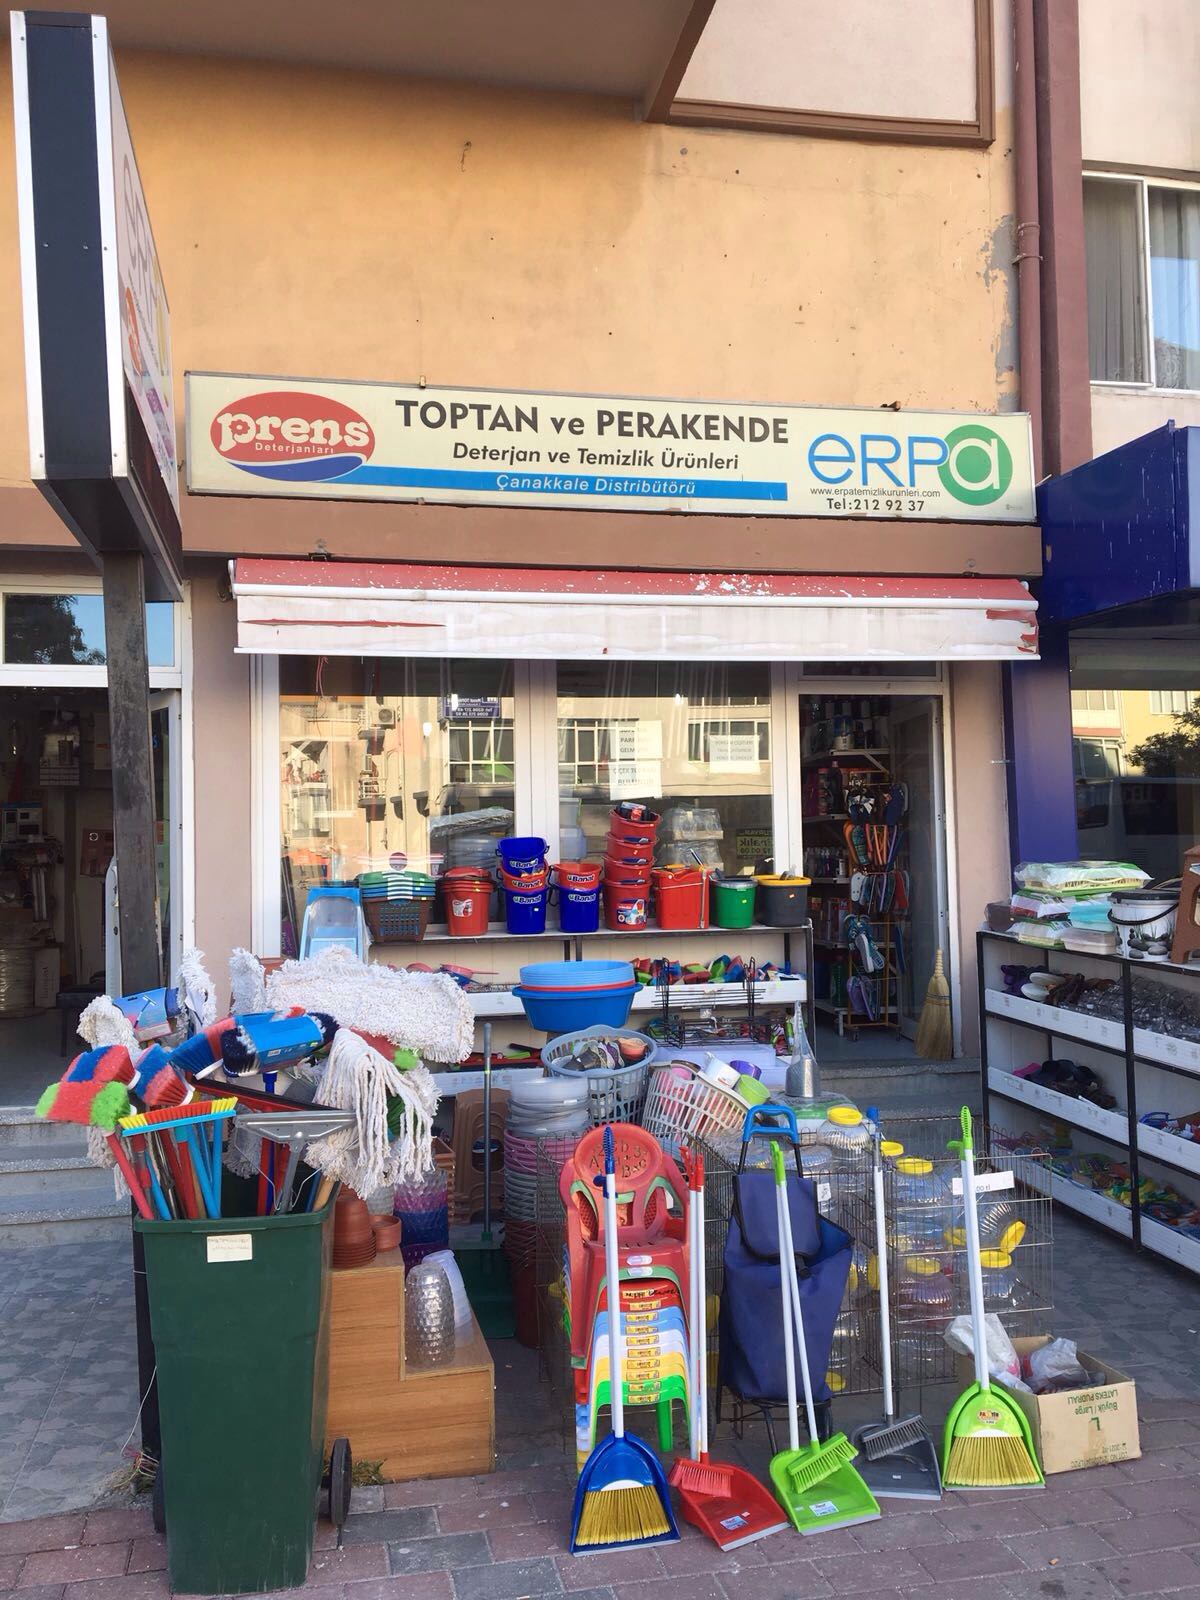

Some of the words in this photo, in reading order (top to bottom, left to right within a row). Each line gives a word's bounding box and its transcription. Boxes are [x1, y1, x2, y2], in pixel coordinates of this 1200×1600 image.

[395, 400, 539, 433] TOPTAN
[550, 415, 586, 435] ve
[597, 409, 789, 444] PERAKENDE
[216, 411, 371, 453] prens
[254, 441, 334, 455] Deterjanları
[453, 441, 544, 468] Deterjan
[548, 449, 571, 465] ve
[577, 446, 655, 468] Temizlik
[661, 447, 740, 471] Ürünleri
[496, 475, 590, 492] Çanakkale
[594, 477, 697, 496] Distribütörü
[809, 485, 942, 499] www.erpatemizlikurunleri.com
[826, 497, 882, 512] Tel:212
[885, 499, 904, 512] 92
[907, 500, 925, 512] 37
[1090, 1417, 1101, 1431] L
